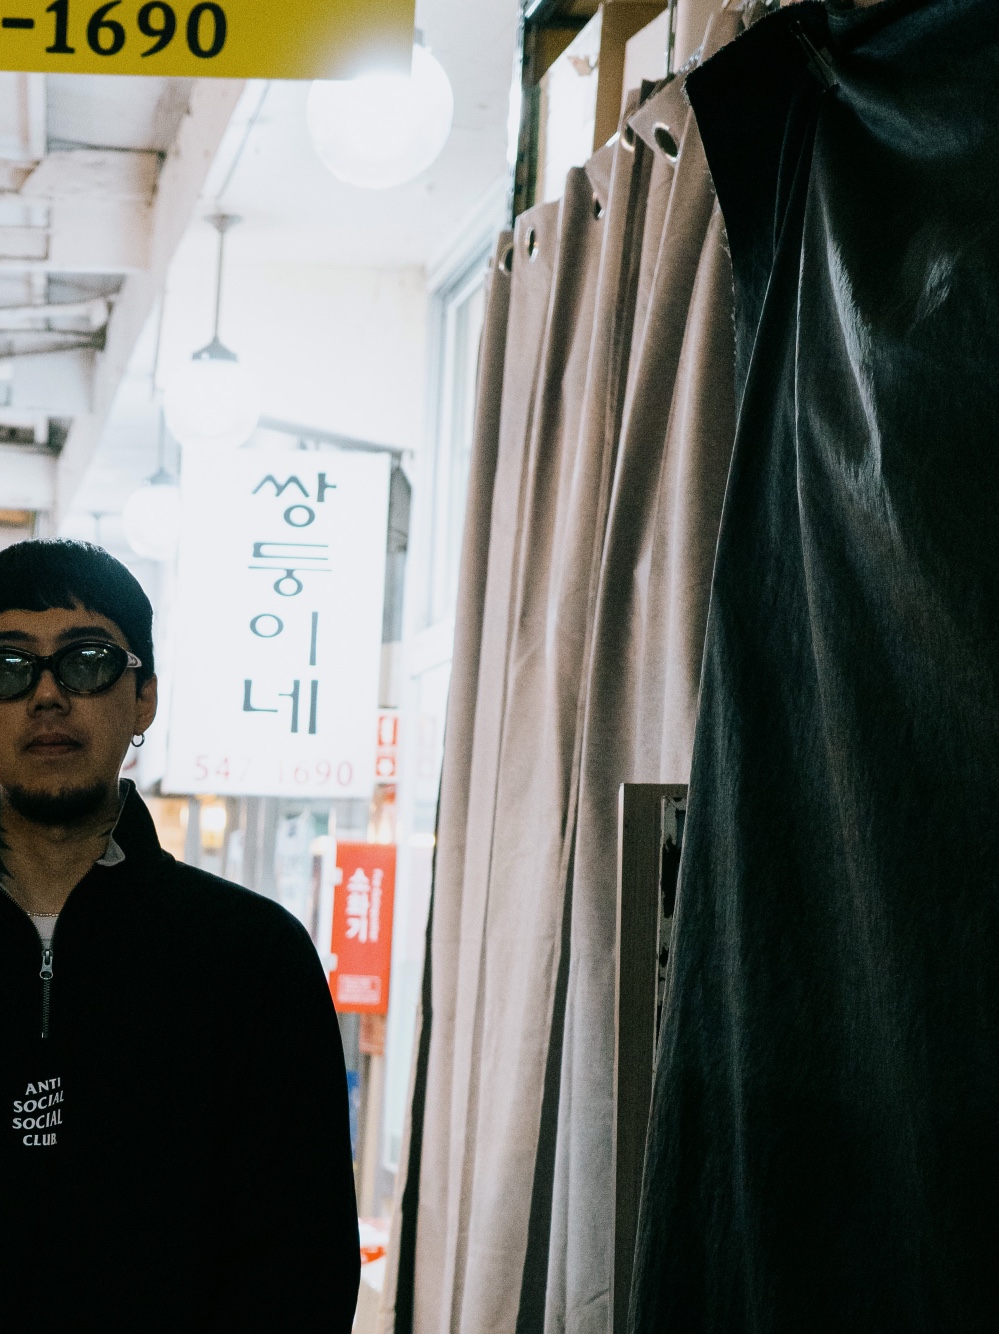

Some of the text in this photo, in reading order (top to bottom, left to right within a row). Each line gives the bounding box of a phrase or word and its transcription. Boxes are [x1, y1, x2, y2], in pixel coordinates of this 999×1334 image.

[242, 472, 338, 735] 쌍둥이네
[25, 1076, 61, 1095] ANTI
[13, 1090, 64, 1113] SOCIAL
[12, 1109, 63, 1129] SOCIAL
[22, 1132, 58, 1146] CLUB
